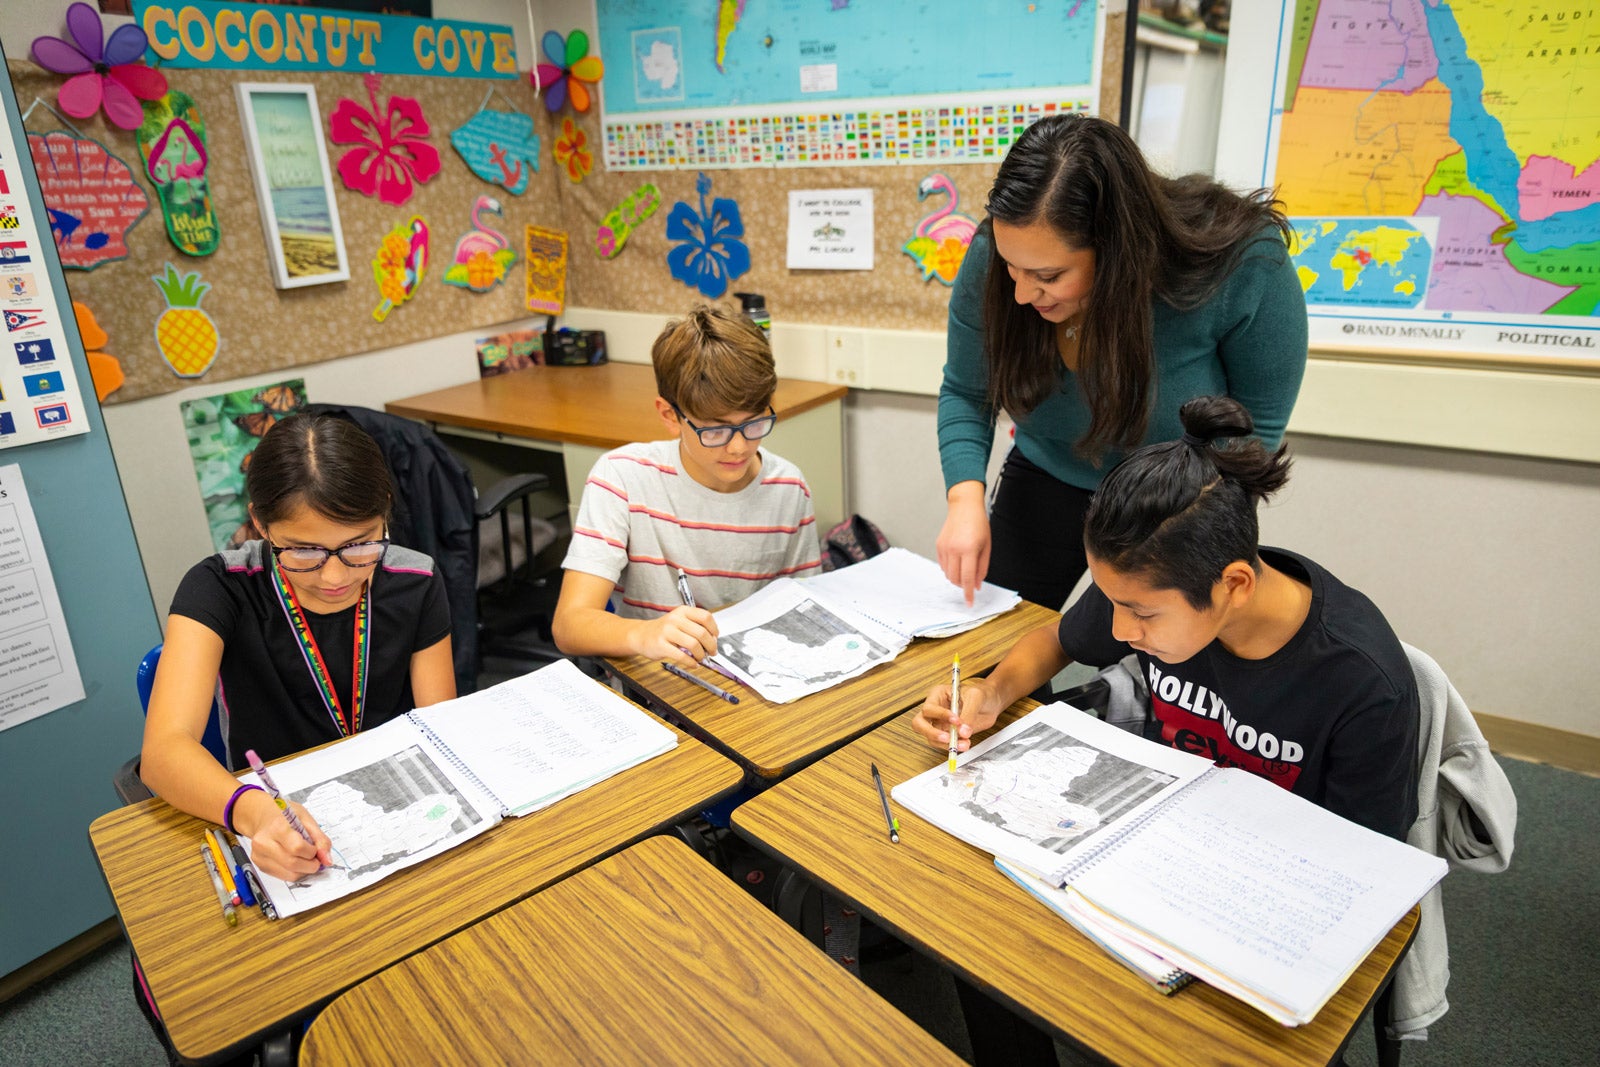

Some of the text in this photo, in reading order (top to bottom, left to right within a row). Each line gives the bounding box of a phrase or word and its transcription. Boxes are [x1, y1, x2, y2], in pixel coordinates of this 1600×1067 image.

[1528, 10, 1593, 23] SAUDI
[1331, 21, 1405, 30] EGYPT
[143, 5, 517, 74] COCONUT COVE
[1335, 151, 1388, 160] SUDAN
[1552, 190, 1591, 199] YEMEN
[1438, 247, 1498, 256] ETHIOPIA
[1356, 324, 1396, 336] RAND
[1496, 331, 1596, 348] POLITICAL
[1150, 662, 1304, 763] HOLLYWOOD
